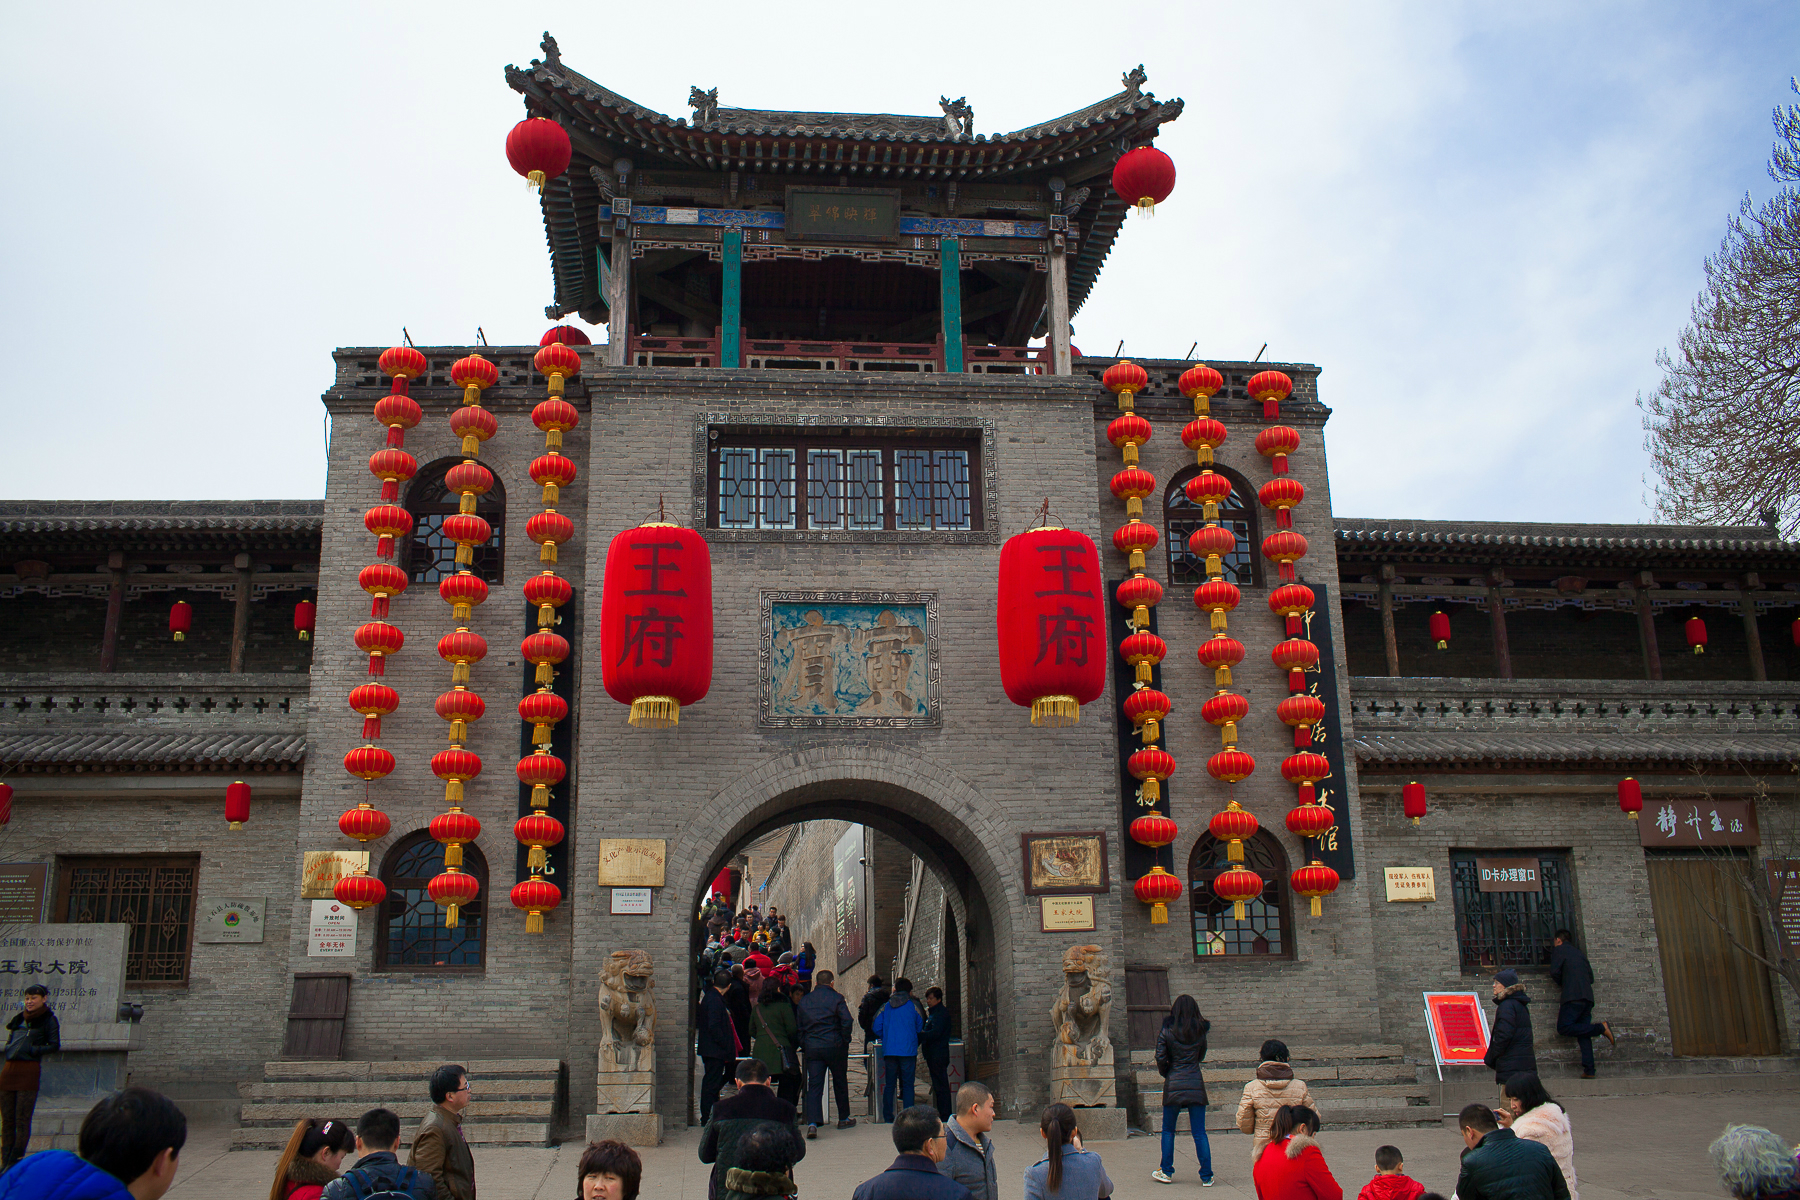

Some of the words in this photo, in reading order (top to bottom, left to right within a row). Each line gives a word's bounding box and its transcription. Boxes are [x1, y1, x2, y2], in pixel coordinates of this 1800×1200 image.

[617, 540, 688, 668] 王府
[1034, 543, 1096, 668] 王府
[1481, 867, 1536, 882] ID卡办理窗口
[0, 959, 90, 975] 王家大院
